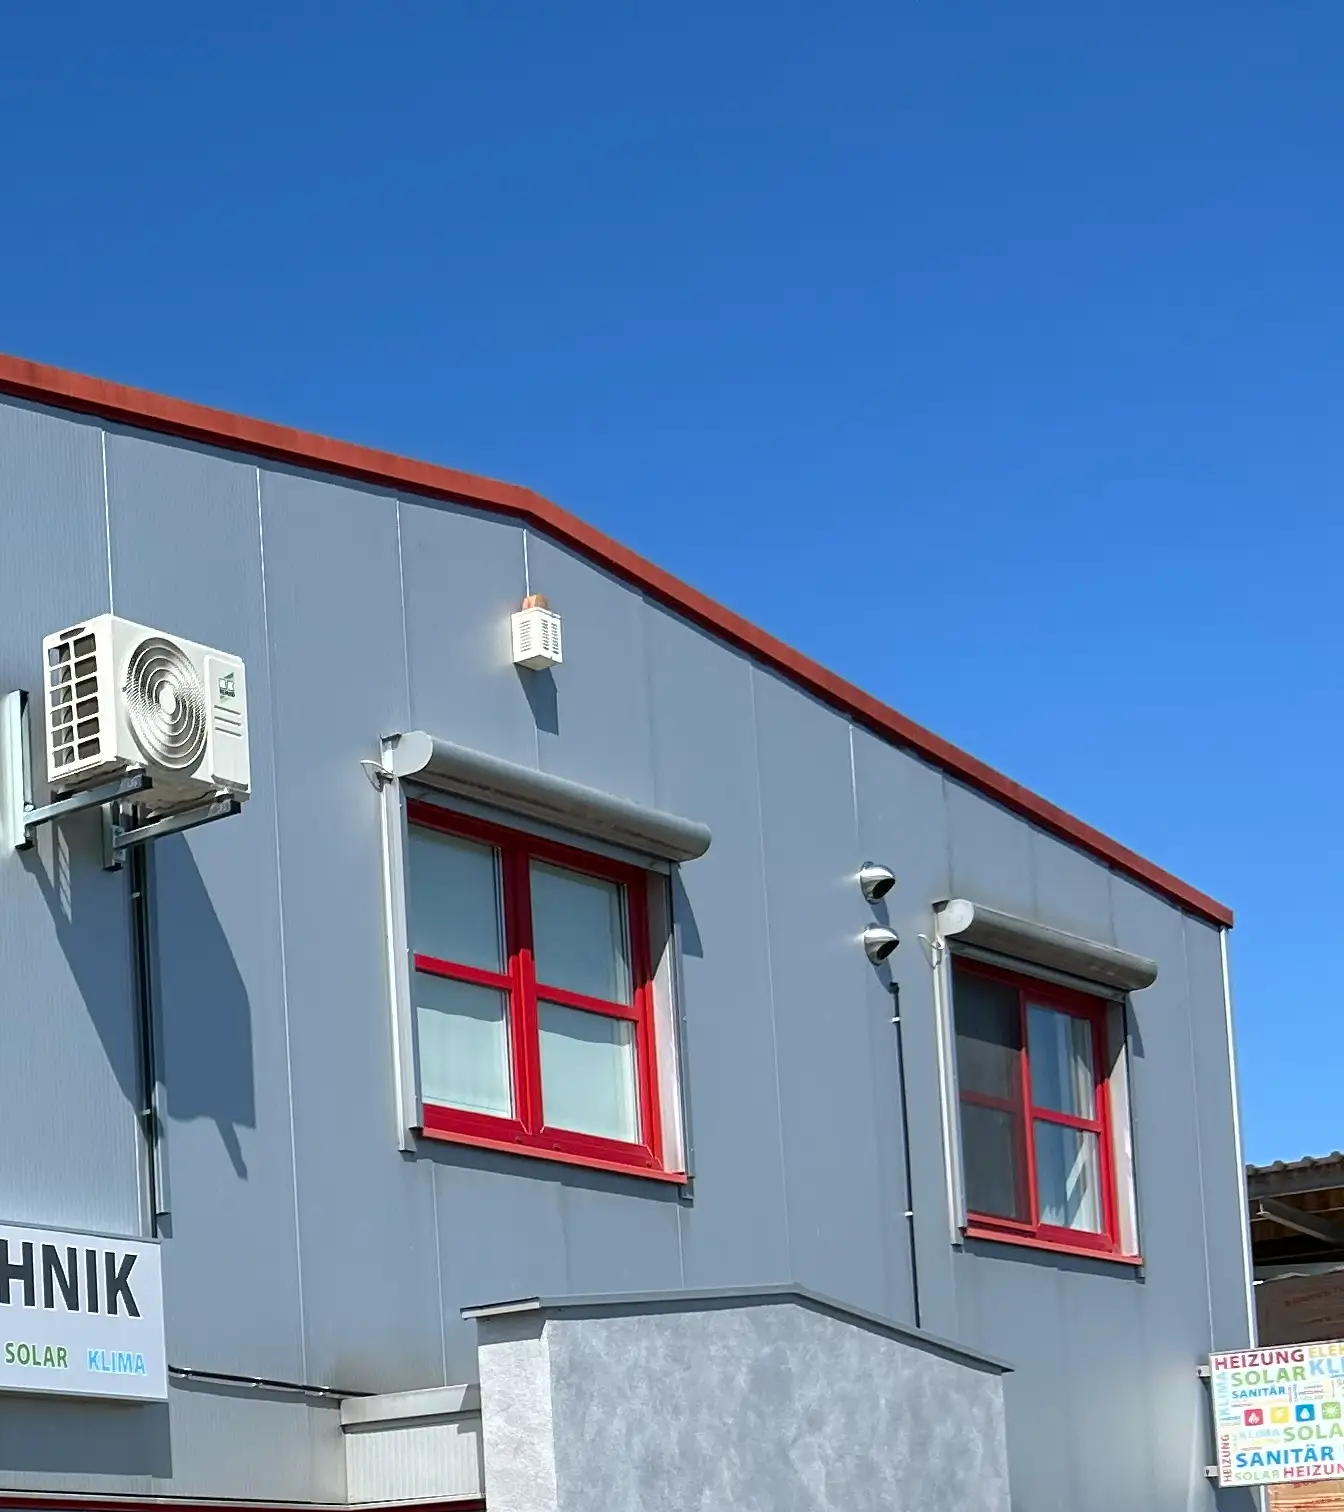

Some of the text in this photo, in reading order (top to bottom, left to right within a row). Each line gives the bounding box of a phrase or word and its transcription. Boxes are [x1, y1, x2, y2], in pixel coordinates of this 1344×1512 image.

[5, 1341, 68, 1370] SOLAR
[88, 1349, 148, 1378] KLIMA
[1215, 1349, 1305, 1370] HEIZUNG
[1231, 1366, 1307, 1387] SOLAR
[1216, 1372, 1230, 1416] KLIMA
[1232, 1386, 1286, 1399] SANITÄR
[1220, 1434, 1232, 1482] HEIZUNG
[1236, 1444, 1334, 1467] SANITÄR
[1235, 1470, 1279, 1481] SOLAR
